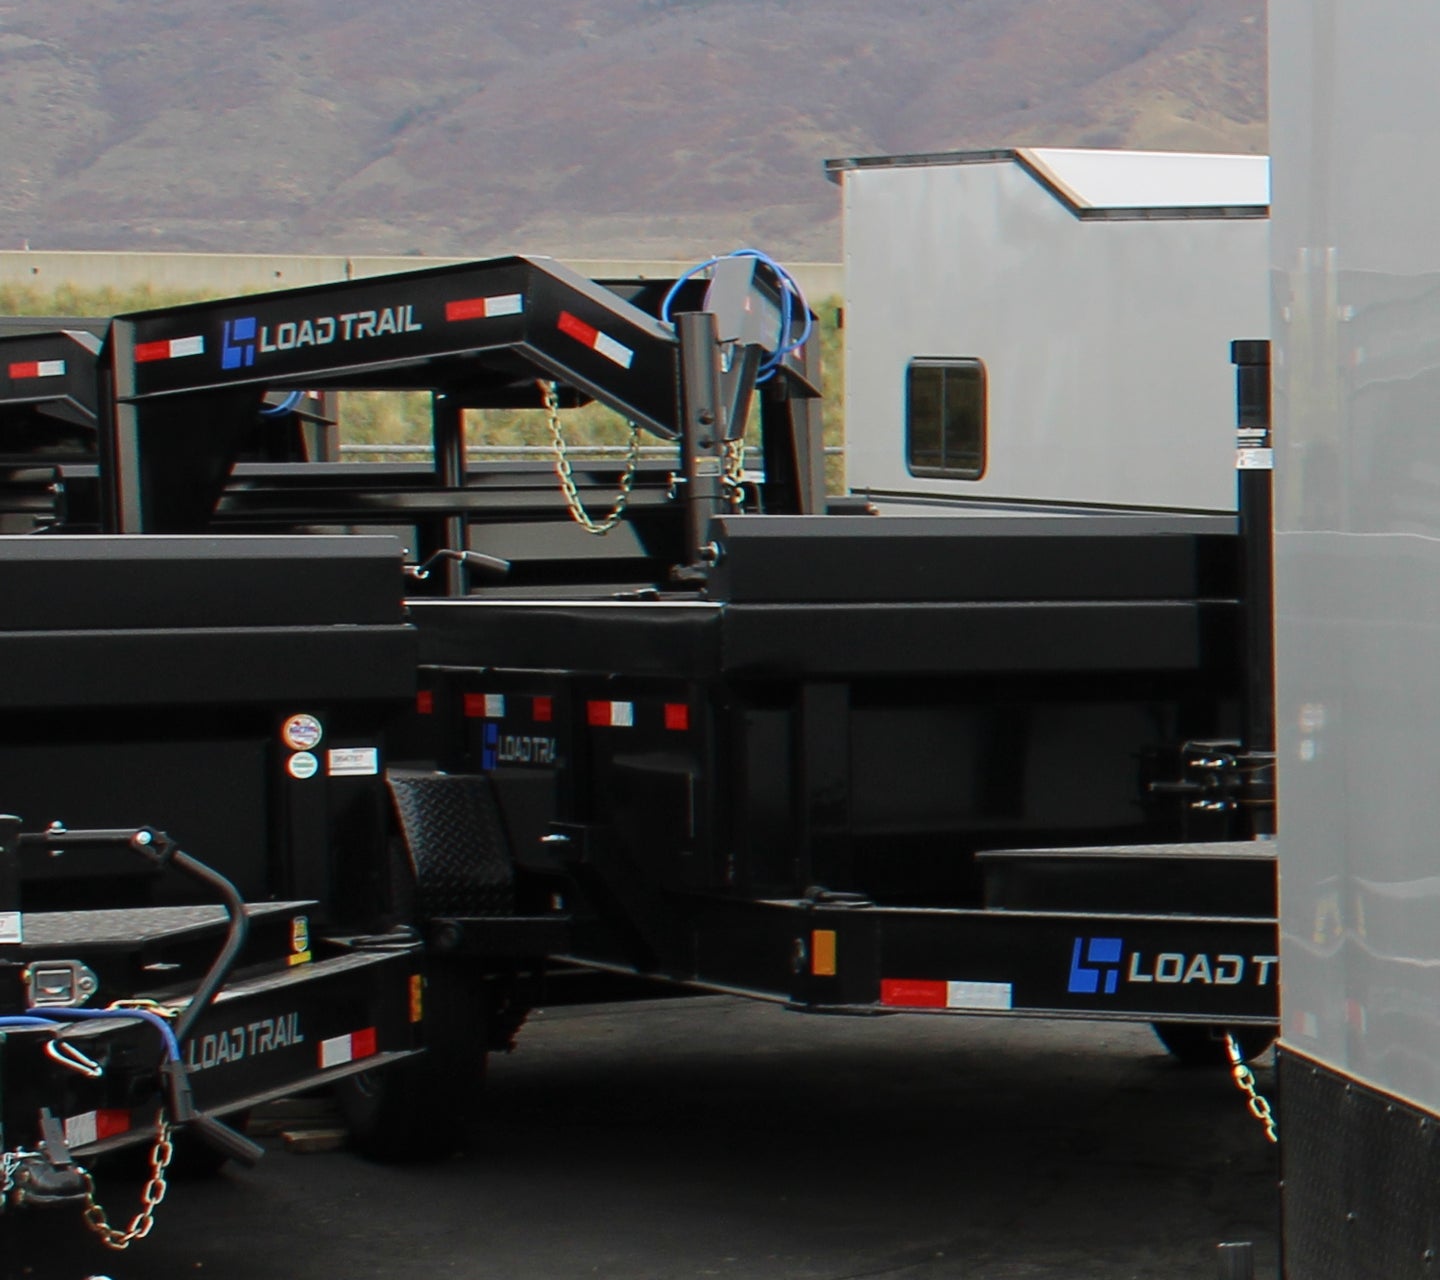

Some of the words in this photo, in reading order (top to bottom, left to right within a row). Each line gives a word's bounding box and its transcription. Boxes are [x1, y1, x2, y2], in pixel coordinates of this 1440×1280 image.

[259, 319, 336, 353] LOAD
[339, 304, 423, 341] TRAIL
[1127, 952, 1244, 984] LOAD
[186, 1026, 245, 1073] LOAD
[248, 1011, 304, 1056] TRAIL
